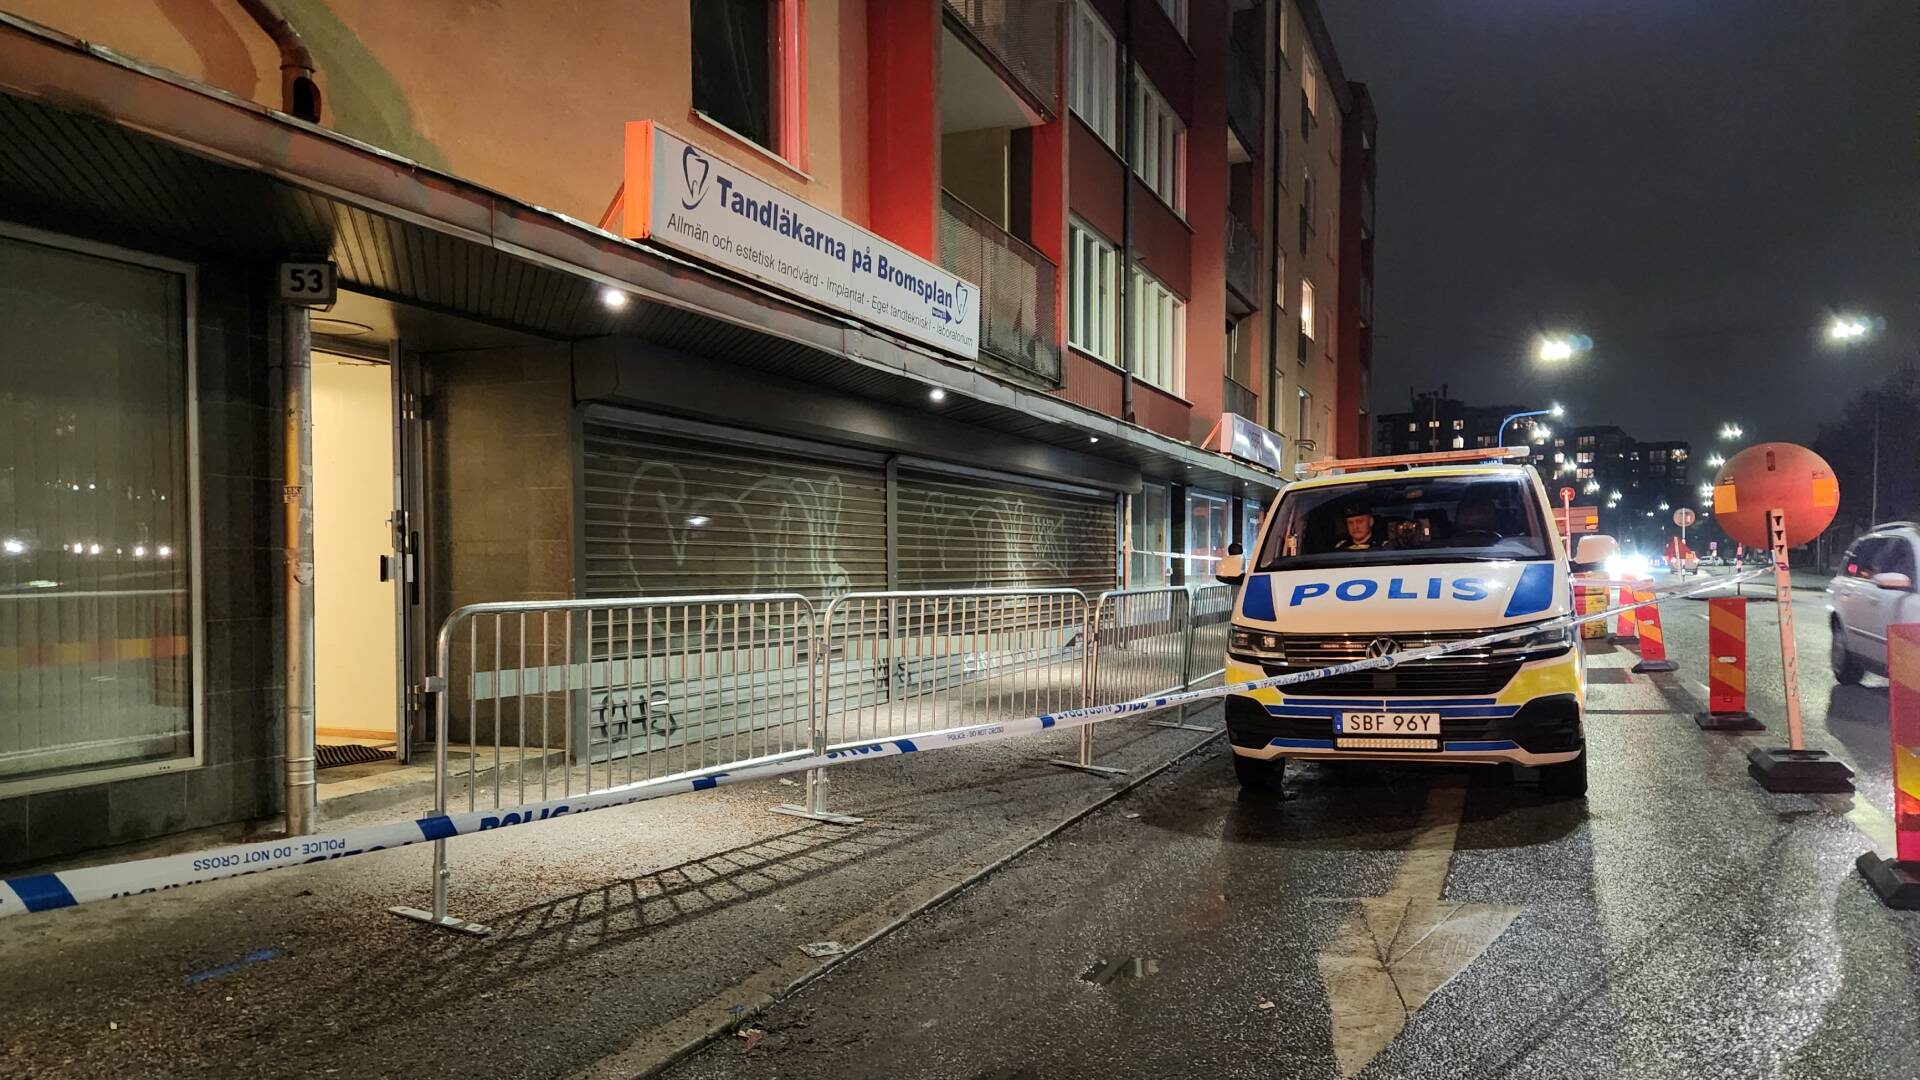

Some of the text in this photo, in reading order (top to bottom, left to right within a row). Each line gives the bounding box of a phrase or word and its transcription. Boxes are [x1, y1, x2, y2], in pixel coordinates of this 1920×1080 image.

[717, 175, 953, 308] Tandläkarna på Bromsplan
[290, 269, 323, 293] 53
[666, 213, 709, 243] Allmän
[712, 231, 733, 252] och
[736, 244, 775, 271] estetisk
[778, 260, 819, 287] tandvård
[826, 276, 865, 305] Implantat
[871, 296, 889, 315] Eget
[936, 323, 973, 349] laboratorium
[1289, 577, 1488, 606] POLIS
[1350, 715, 1430, 731] SBF 96Y
[273, 846, 292, 859] DO
[302, 838, 346, 855] POLICE
[192, 854, 240, 872] CROSS
[243, 850, 270, 864] NOT
